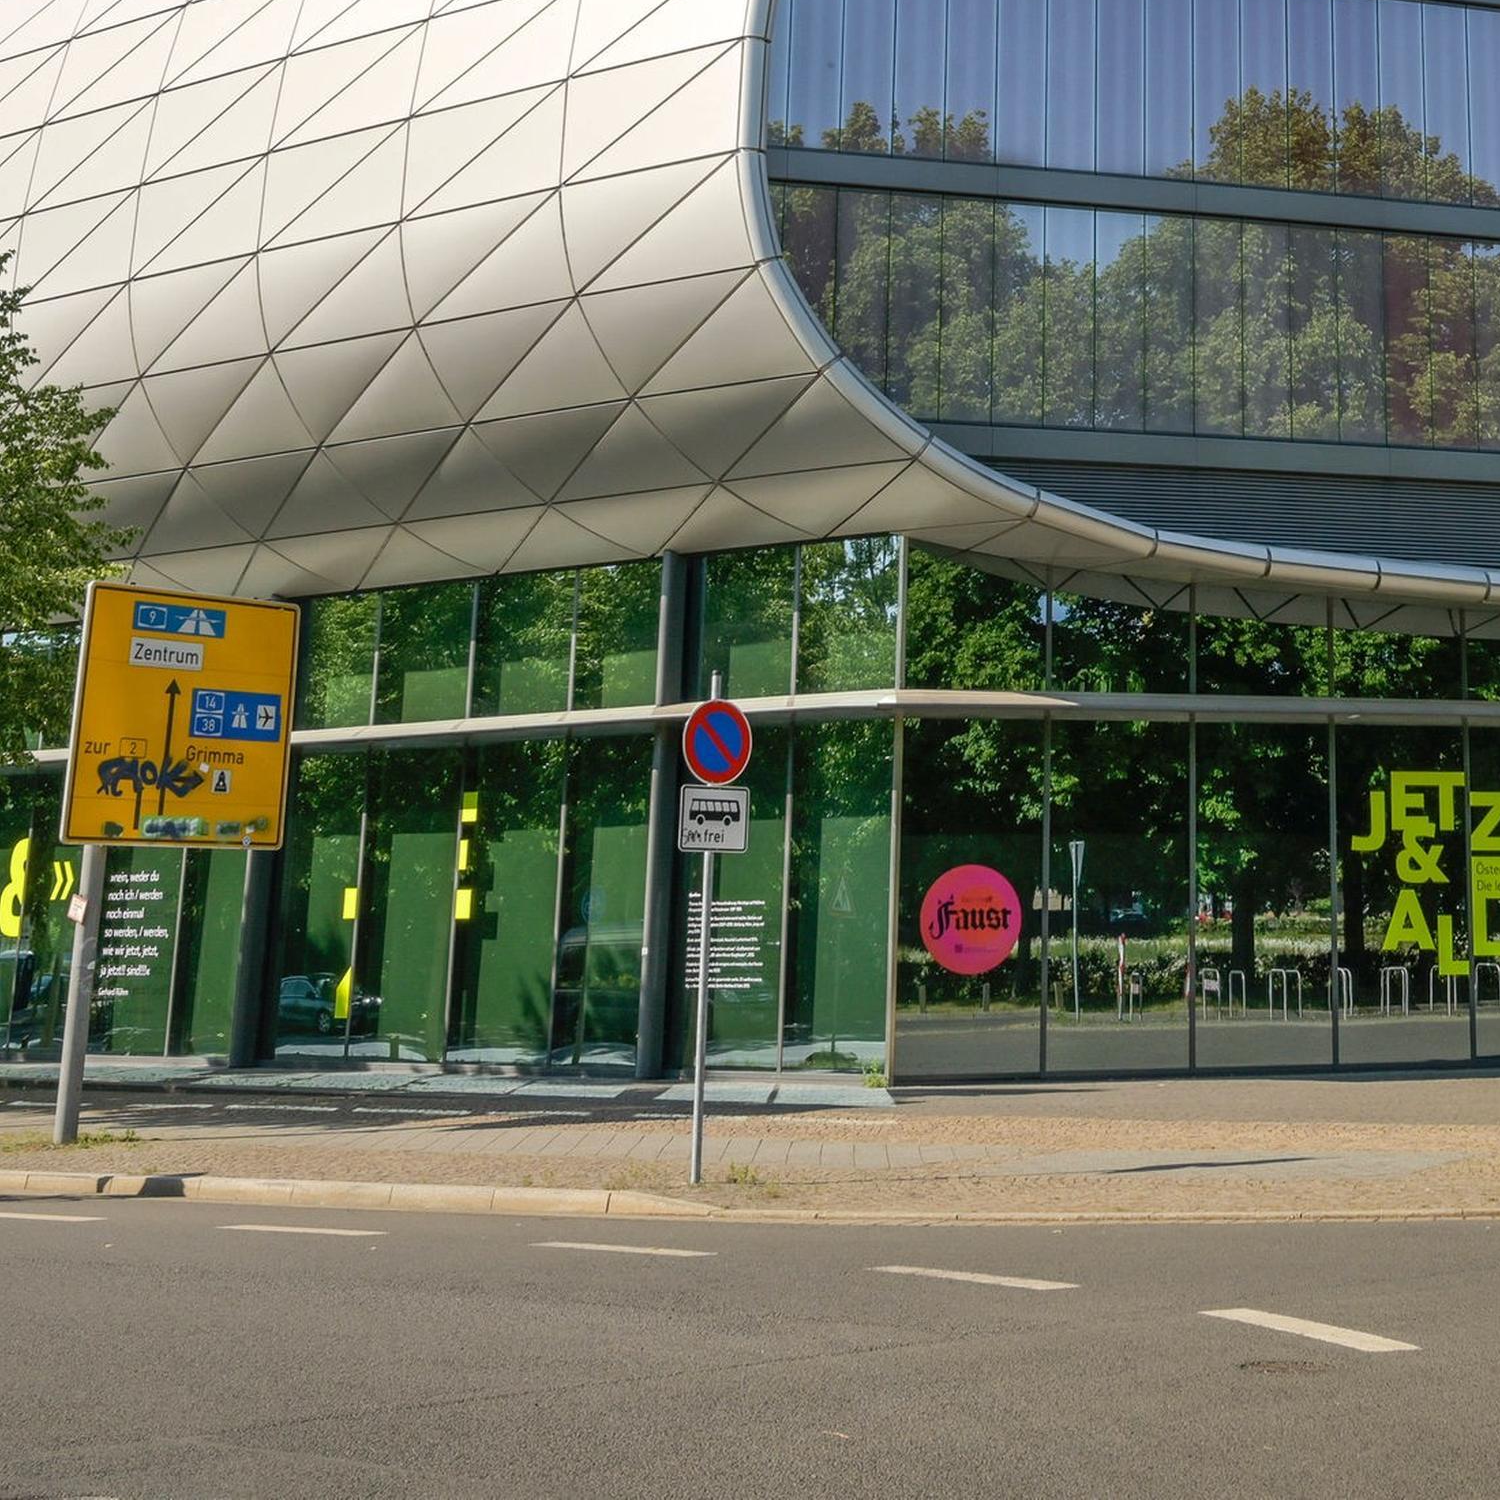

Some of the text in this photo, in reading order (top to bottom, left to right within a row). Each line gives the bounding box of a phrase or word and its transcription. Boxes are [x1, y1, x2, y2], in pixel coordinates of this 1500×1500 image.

[149, 610, 156, 623] 9
[134, 643, 199, 665] Zentrum
[204, 695, 216, 709] 14
[201, 718, 215, 732] 38
[84, 741, 137, 755] zur 2
[185, 745, 245, 764] Grimma
[704, 829, 725, 843] frei
[1396, 822, 1449, 884] &
[1477, 880, 1492, 891] Die
[929, 893, 1011, 939] Faust
